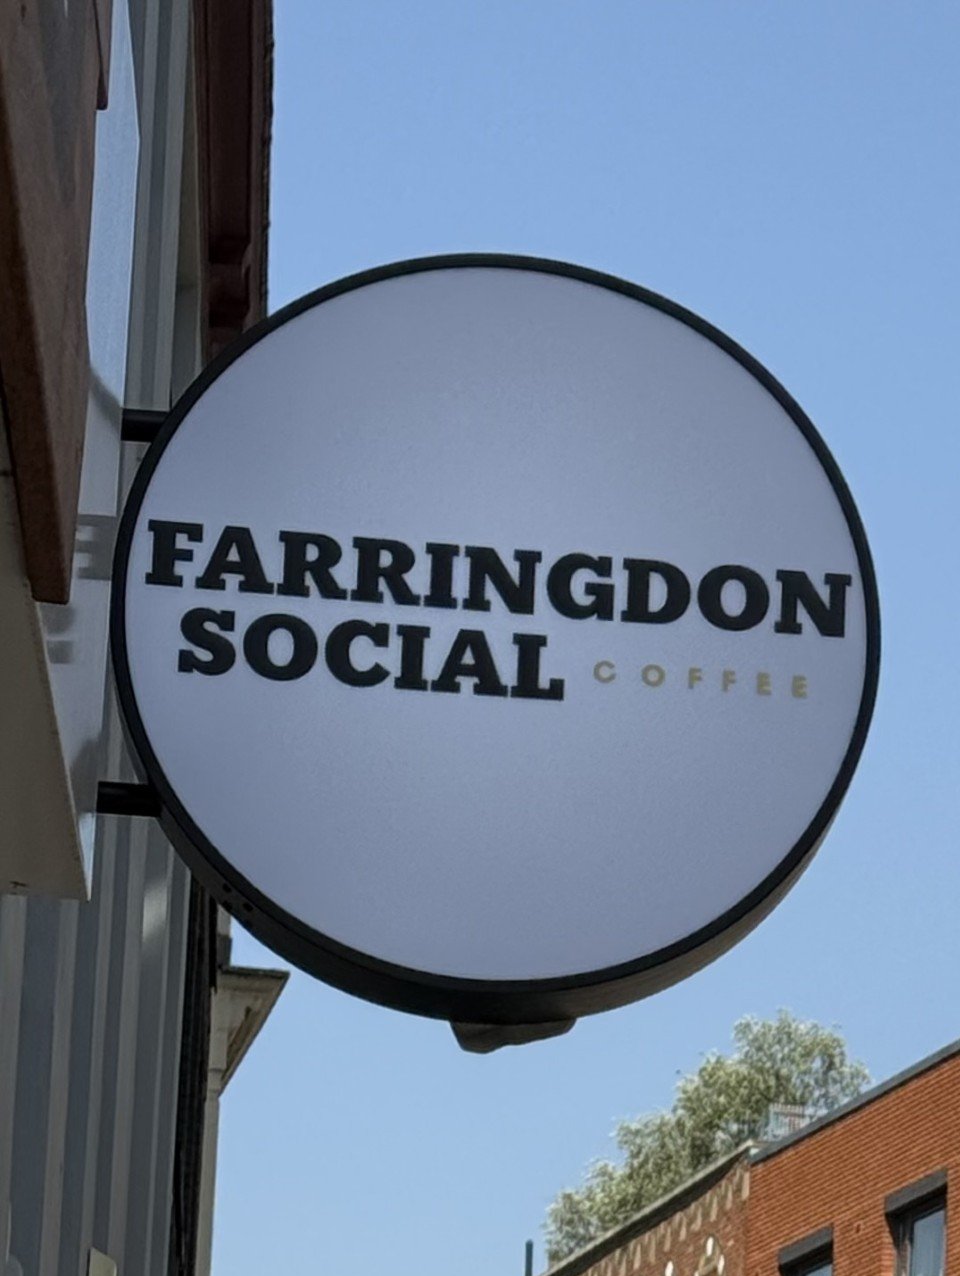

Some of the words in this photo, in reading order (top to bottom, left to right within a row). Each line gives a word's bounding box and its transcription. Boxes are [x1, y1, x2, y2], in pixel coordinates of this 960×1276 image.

[145, 518, 853, 637] FARRINGDON
[177, 606, 565, 701] SOCIAL
[592, 659, 809, 700] COFFEE
